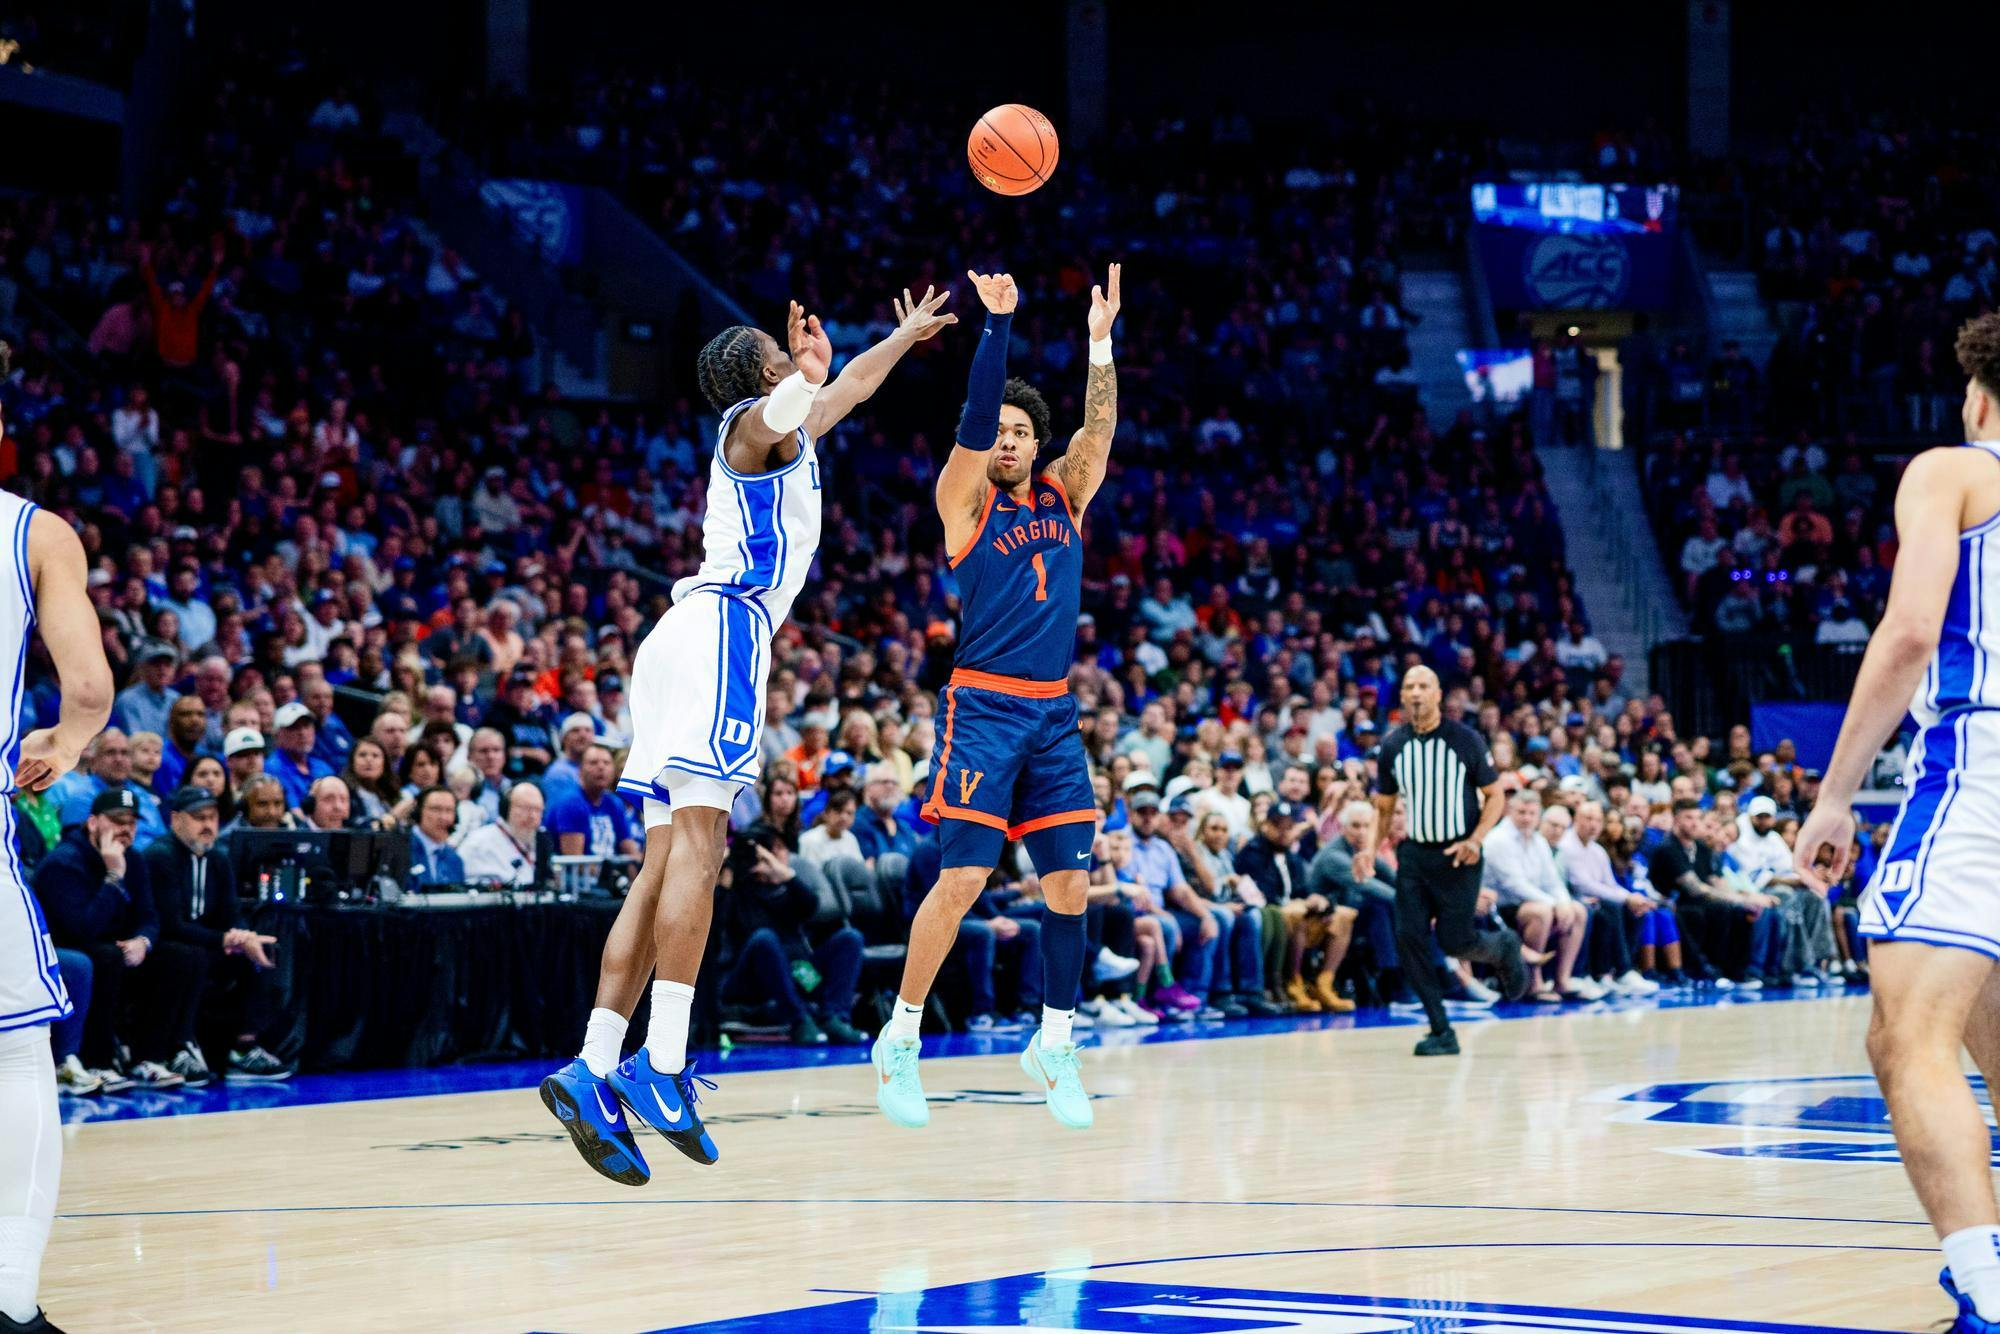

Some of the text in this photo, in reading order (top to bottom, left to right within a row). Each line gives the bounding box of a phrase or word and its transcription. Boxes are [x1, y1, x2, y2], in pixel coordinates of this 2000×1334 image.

[992, 519, 1070, 556] VIRGINIA
[1031, 552, 1048, 601] 1
[720, 716, 751, 746] D
[960, 769, 984, 804] V
[1880, 859, 1915, 893] D
